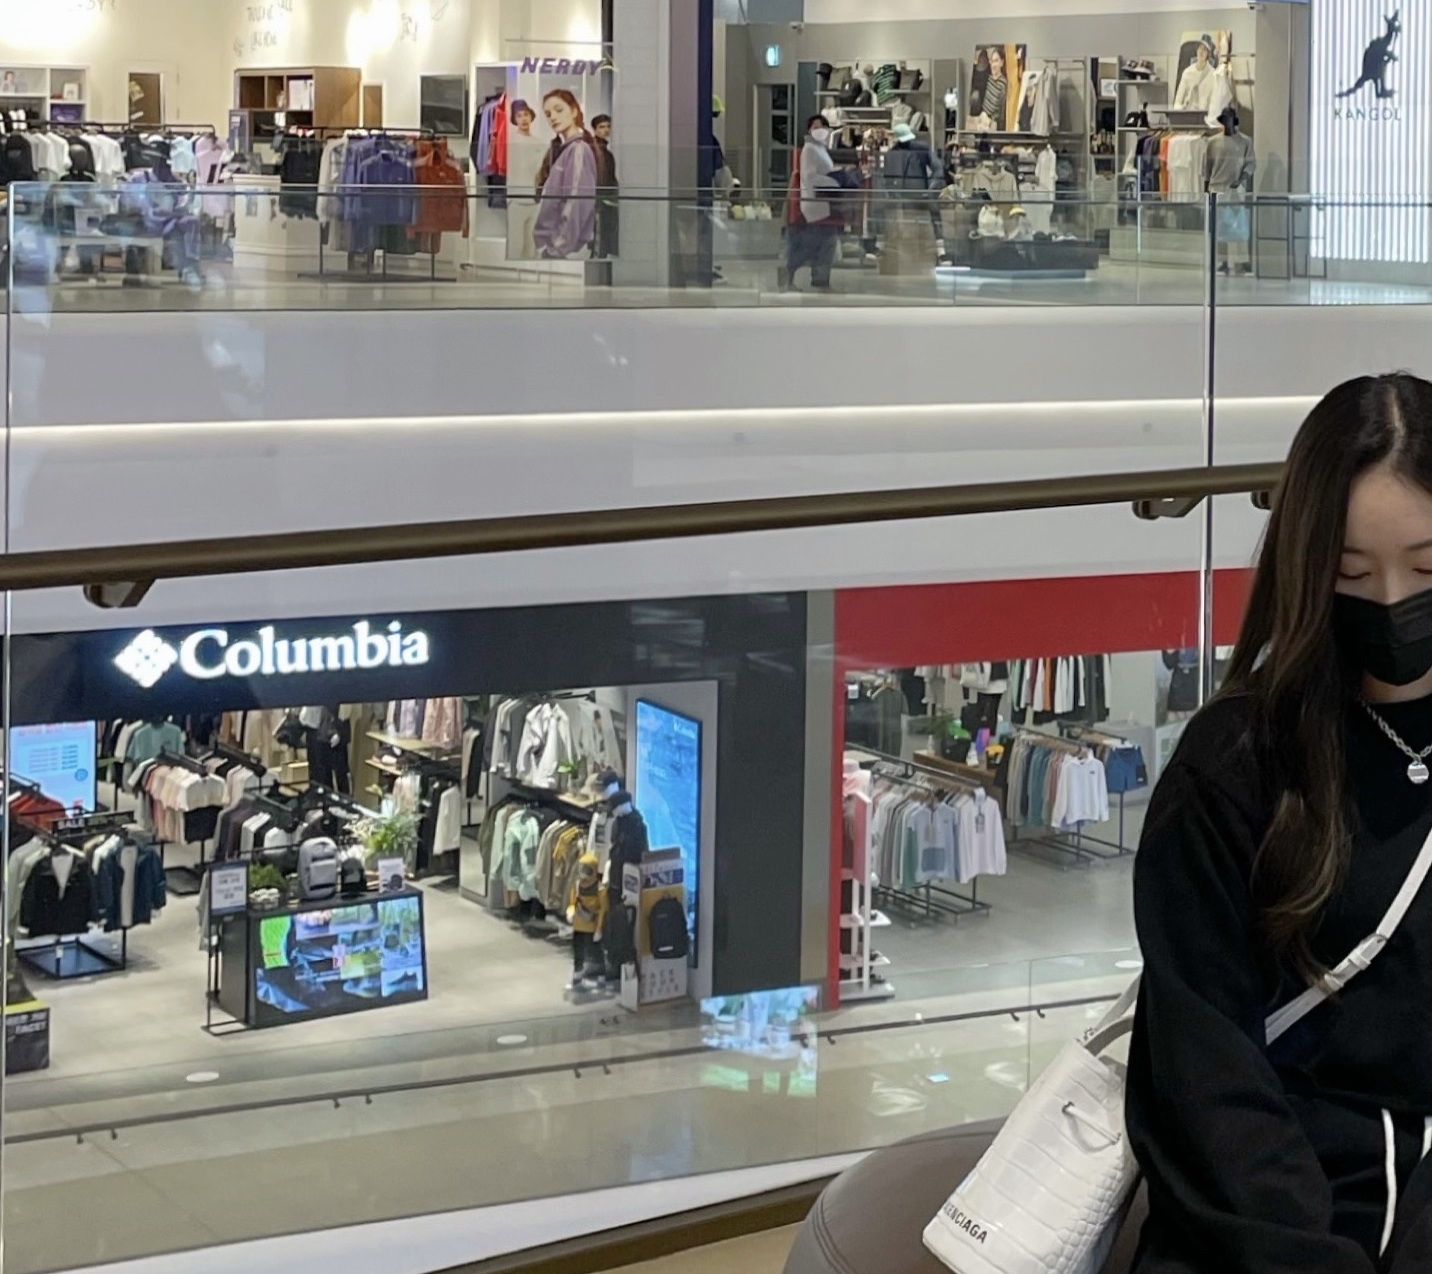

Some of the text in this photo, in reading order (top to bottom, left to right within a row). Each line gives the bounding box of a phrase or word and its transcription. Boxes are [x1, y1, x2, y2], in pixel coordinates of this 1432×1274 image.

[520, 56, 604, 76] NERDY
[1334, 107, 1401, 121] KANGOL
[179, 621, 430, 679] Columbia
[944, 1203, 988, 1244] ENCIAGA
